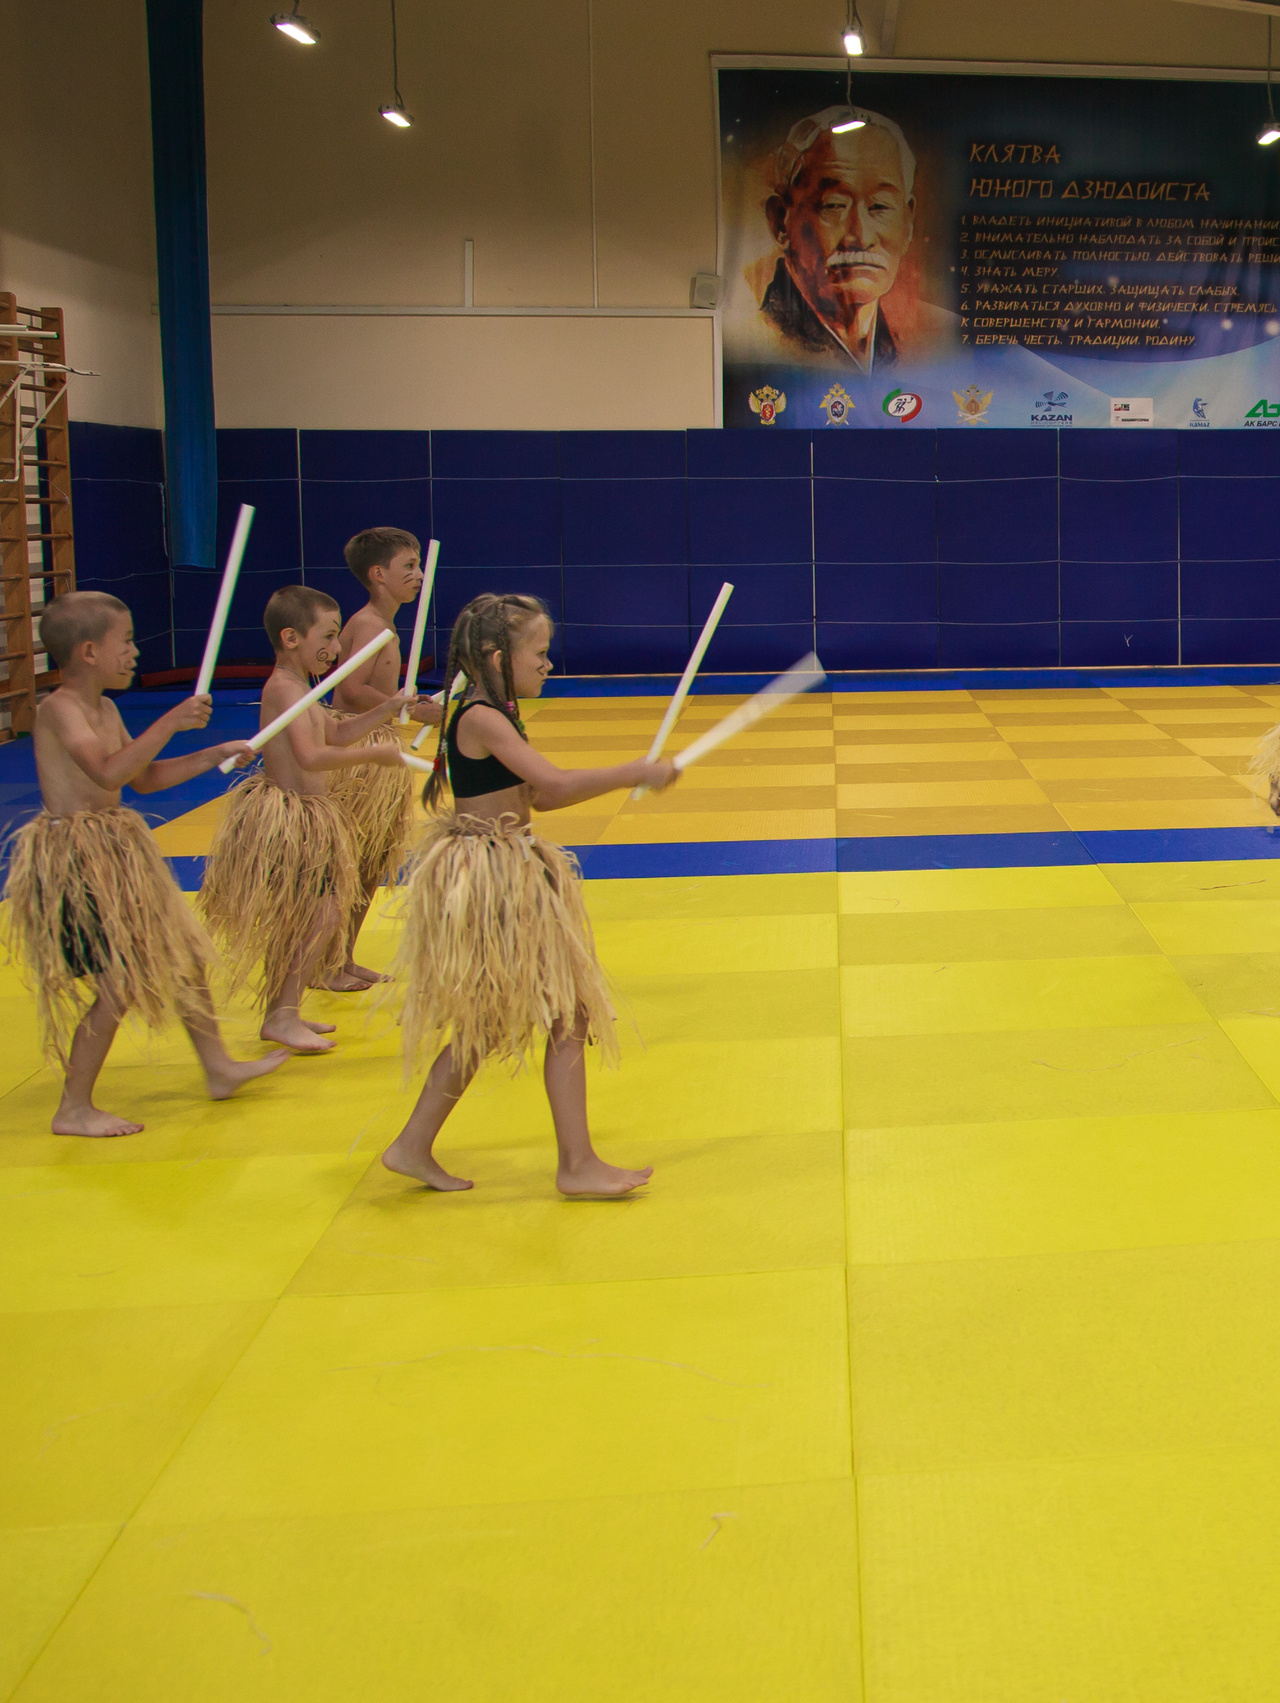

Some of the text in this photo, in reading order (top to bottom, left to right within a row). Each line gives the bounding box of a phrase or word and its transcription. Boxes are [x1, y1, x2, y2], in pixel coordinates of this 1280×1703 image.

[969, 143, 1061, 164] КЛЯТВА
[969, 178, 1210, 201] ЮНОГО ДЗЮДОИСТА
[972, 215, 1032, 226] ВЛАДЕТЬ
[1036, 216, 1132, 230] ИНИЦИАТИВОЙ
[1136, 217, 1143, 227] В
[1147, 218, 1194, 228] ЛЮБОМ
[975, 232, 1074, 243] ВНИМАТЕЛЬНО
[1079, 234, 1161, 245] НАБЛЮДАТЬ
[1166, 235, 1182, 245] ЗА
[1187, 234, 1224, 245] СОБОЙ
[1228, 236, 1237, 246] И
[974, 249, 1067, 260] ОСМЫСЛИВАТЬ
[1156, 250, 1243, 263] ДЕЙСТВОВАТЬ
[974, 266, 1017, 277] ЗНАТЬ
[976, 284, 1038, 294] УВАЖАТЬ
[1110, 284, 1185, 298] ЗАЩИЩАТЬ
[975, 300, 1060, 311] РАЗВИВАТЬСЯ
[1064, 301, 1121, 312] ДУХОВНО
[1125, 302, 1134, 311] И
[1214, 302, 1278, 313] СТРЕМЯСЬ
[961, 318, 969, 327] К
[973, 317, 1070, 328] СОВЕРШЕНСТВУ
[1074, 318, 1083, 328] И
[962, 334, 971, 345] 7.
[975, 334, 1019, 345] БЕРЕЧЬ
